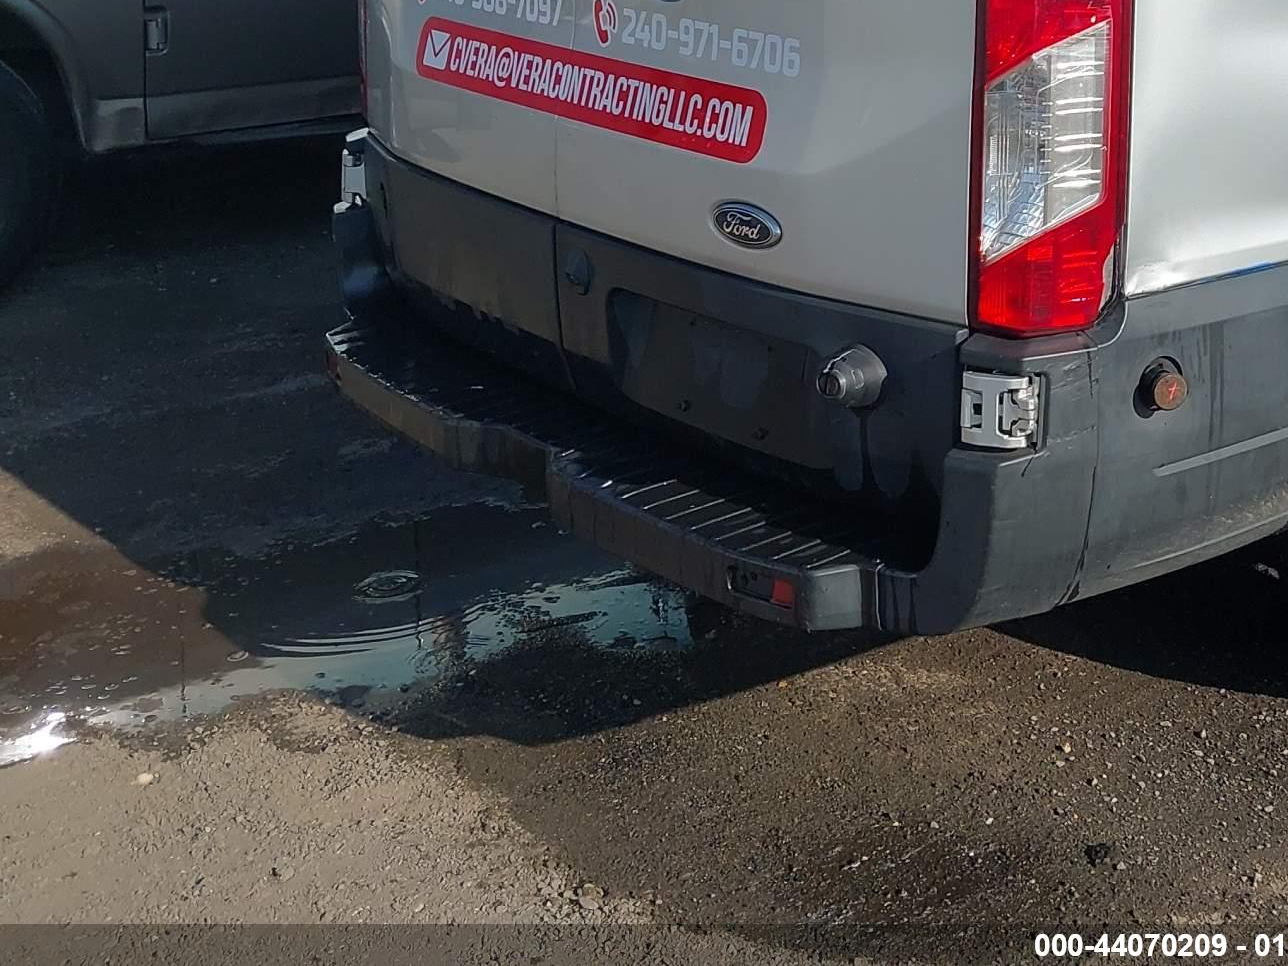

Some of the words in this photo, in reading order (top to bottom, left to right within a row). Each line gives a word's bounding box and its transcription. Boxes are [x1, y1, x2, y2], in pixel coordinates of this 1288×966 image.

[622, 8, 802, 77] 240-971-6706
[450, 35, 754, 148] CVERA@VERACONTRACTINGLLC.COM
[722, 211, 761, 241] Ford
